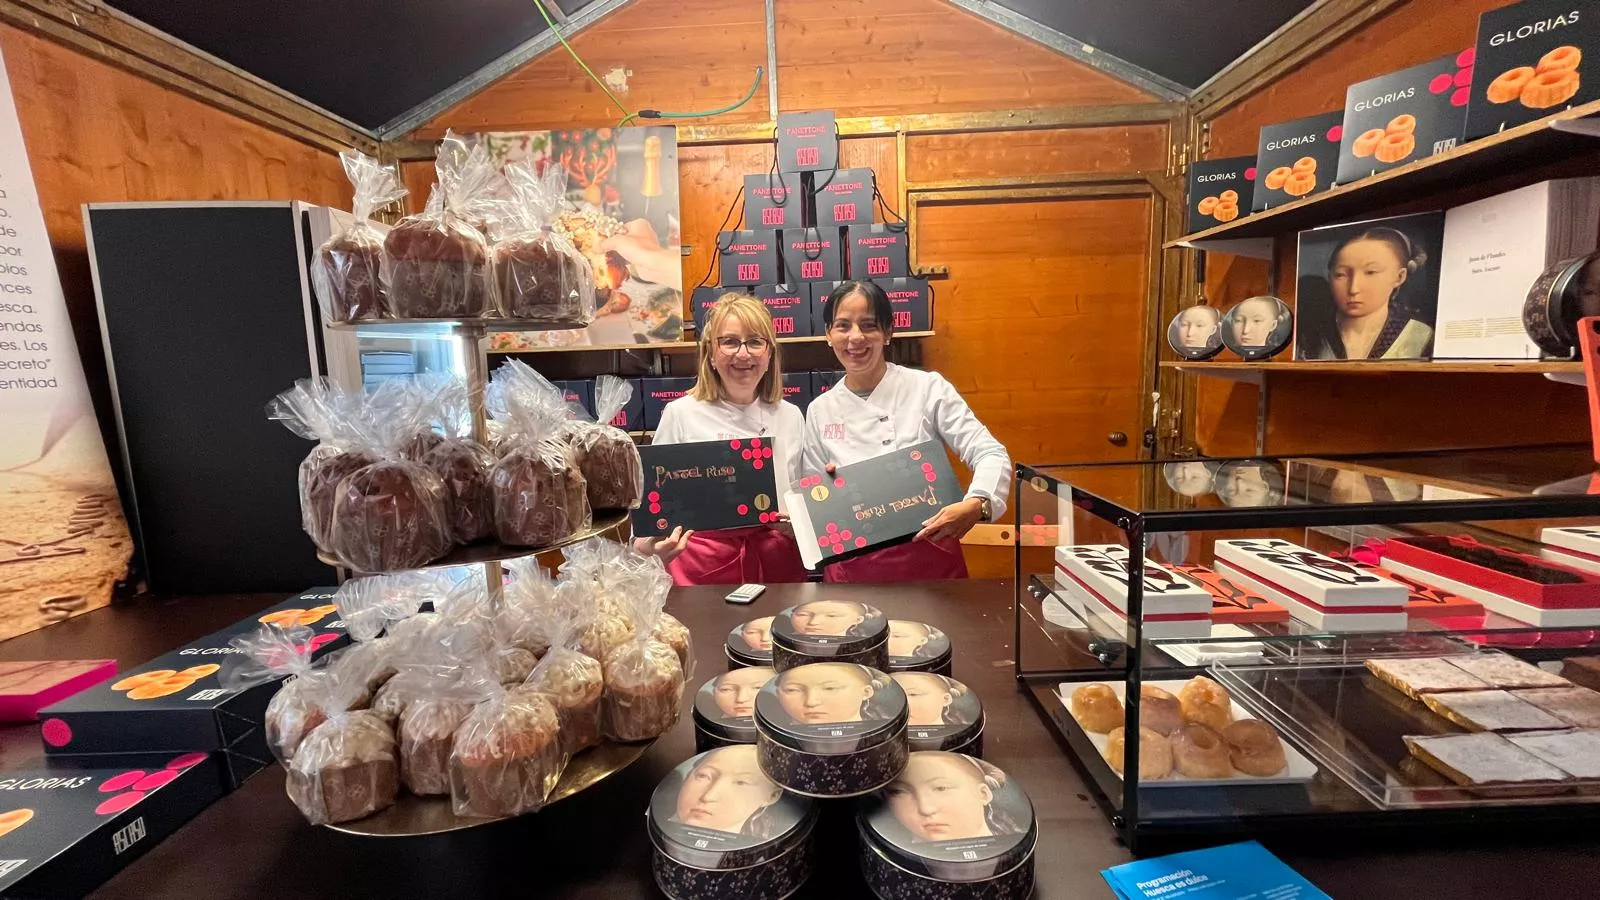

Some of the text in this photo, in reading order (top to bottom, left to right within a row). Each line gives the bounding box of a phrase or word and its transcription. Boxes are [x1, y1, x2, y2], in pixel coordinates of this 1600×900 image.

[1489, 11, 1580, 47] GLORIAS
[1354, 87, 1415, 112] GLORIAS
[1266, 134, 1316, 152] GLORIAS
[1197, 172, 1236, 183] GLORIAS
[858, 236, 897, 245] PANETTONE
[728, 244, 767, 252] PANETTONE
[763, 297, 801, 305] PANETTONE
[24, 340, 48, 351] Los
[179, 647, 244, 656] GLORIA
[0, 776, 92, 790] GLORIAS
[1136, 869, 1194, 890] Programación
[1143, 883, 1176, 898] Huesca
[1174, 880, 1187, 889] es
